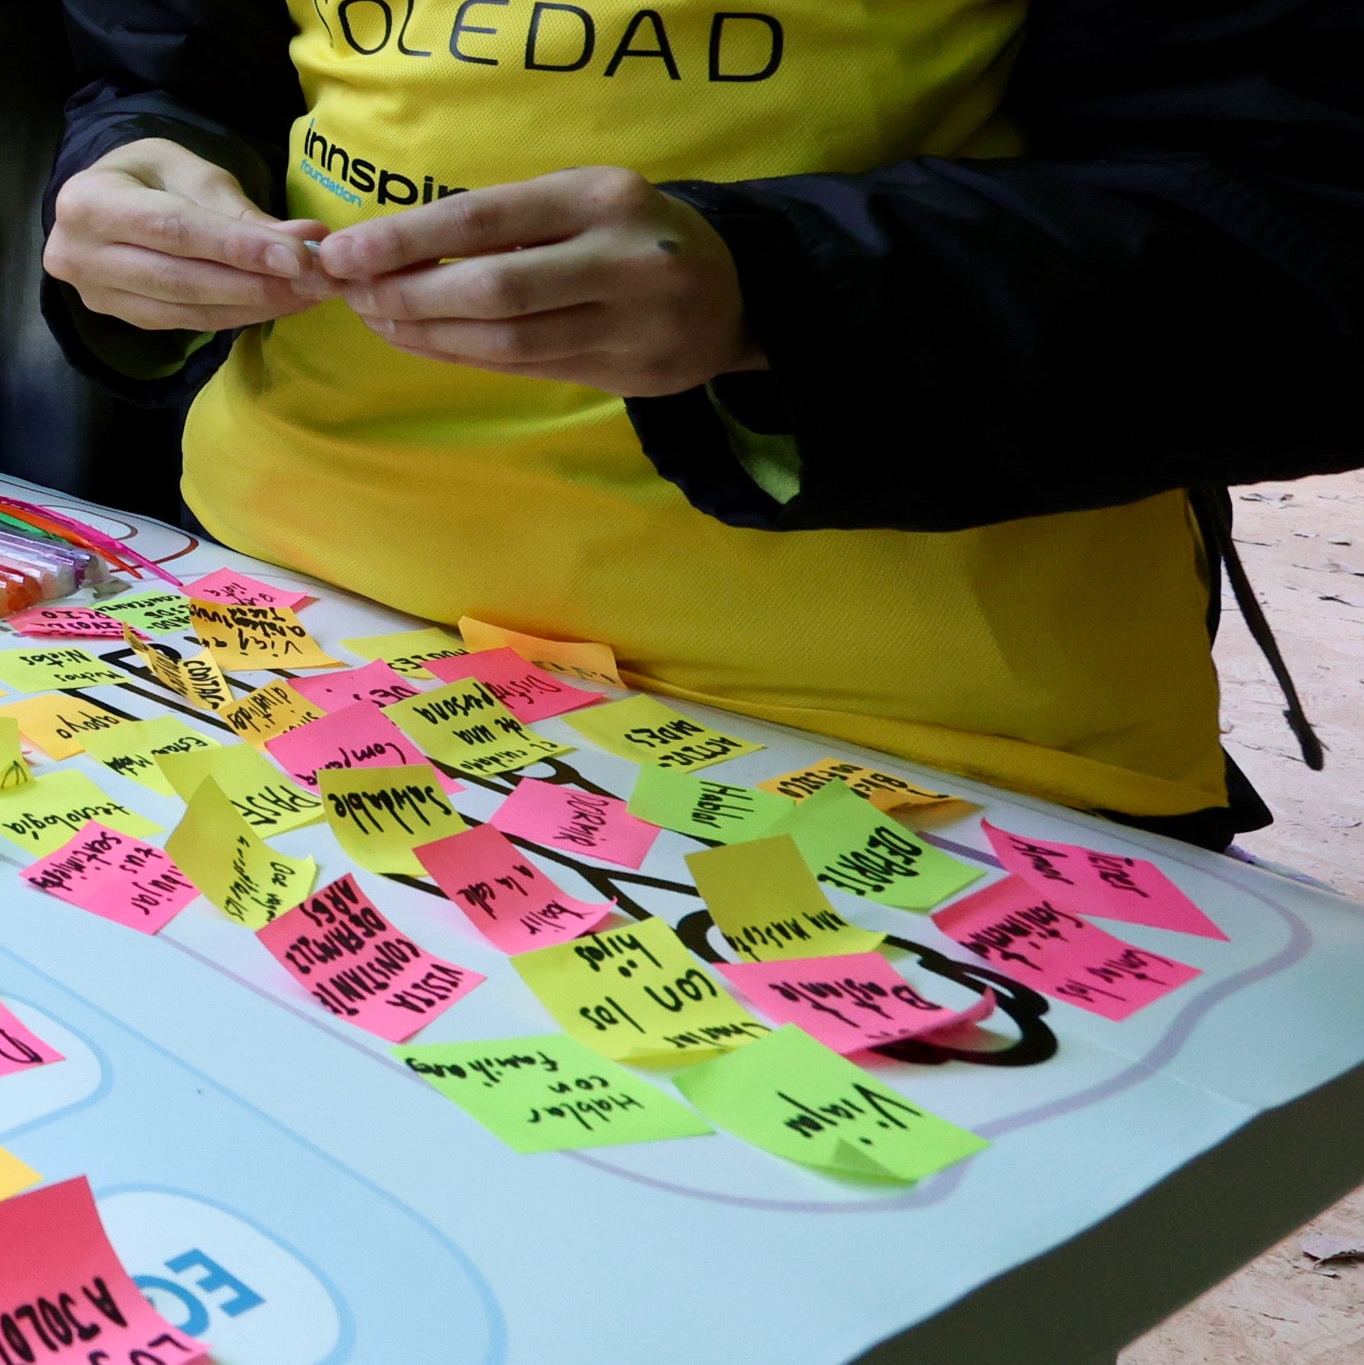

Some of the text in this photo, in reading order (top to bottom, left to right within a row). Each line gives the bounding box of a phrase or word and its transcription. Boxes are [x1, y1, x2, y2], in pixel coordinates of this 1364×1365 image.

[300, 159, 363, 208] foundation
[304, 118, 470, 205] innspir
[328, 787, 452, 834] Saludable
[574, 935, 663, 978] hijos
[580, 968, 718, 1035] con los
[548, 1076, 609, 1095] con
[527, 1094, 645, 1132] Hablar
[777, 1083, 924, 1145] Viajar
